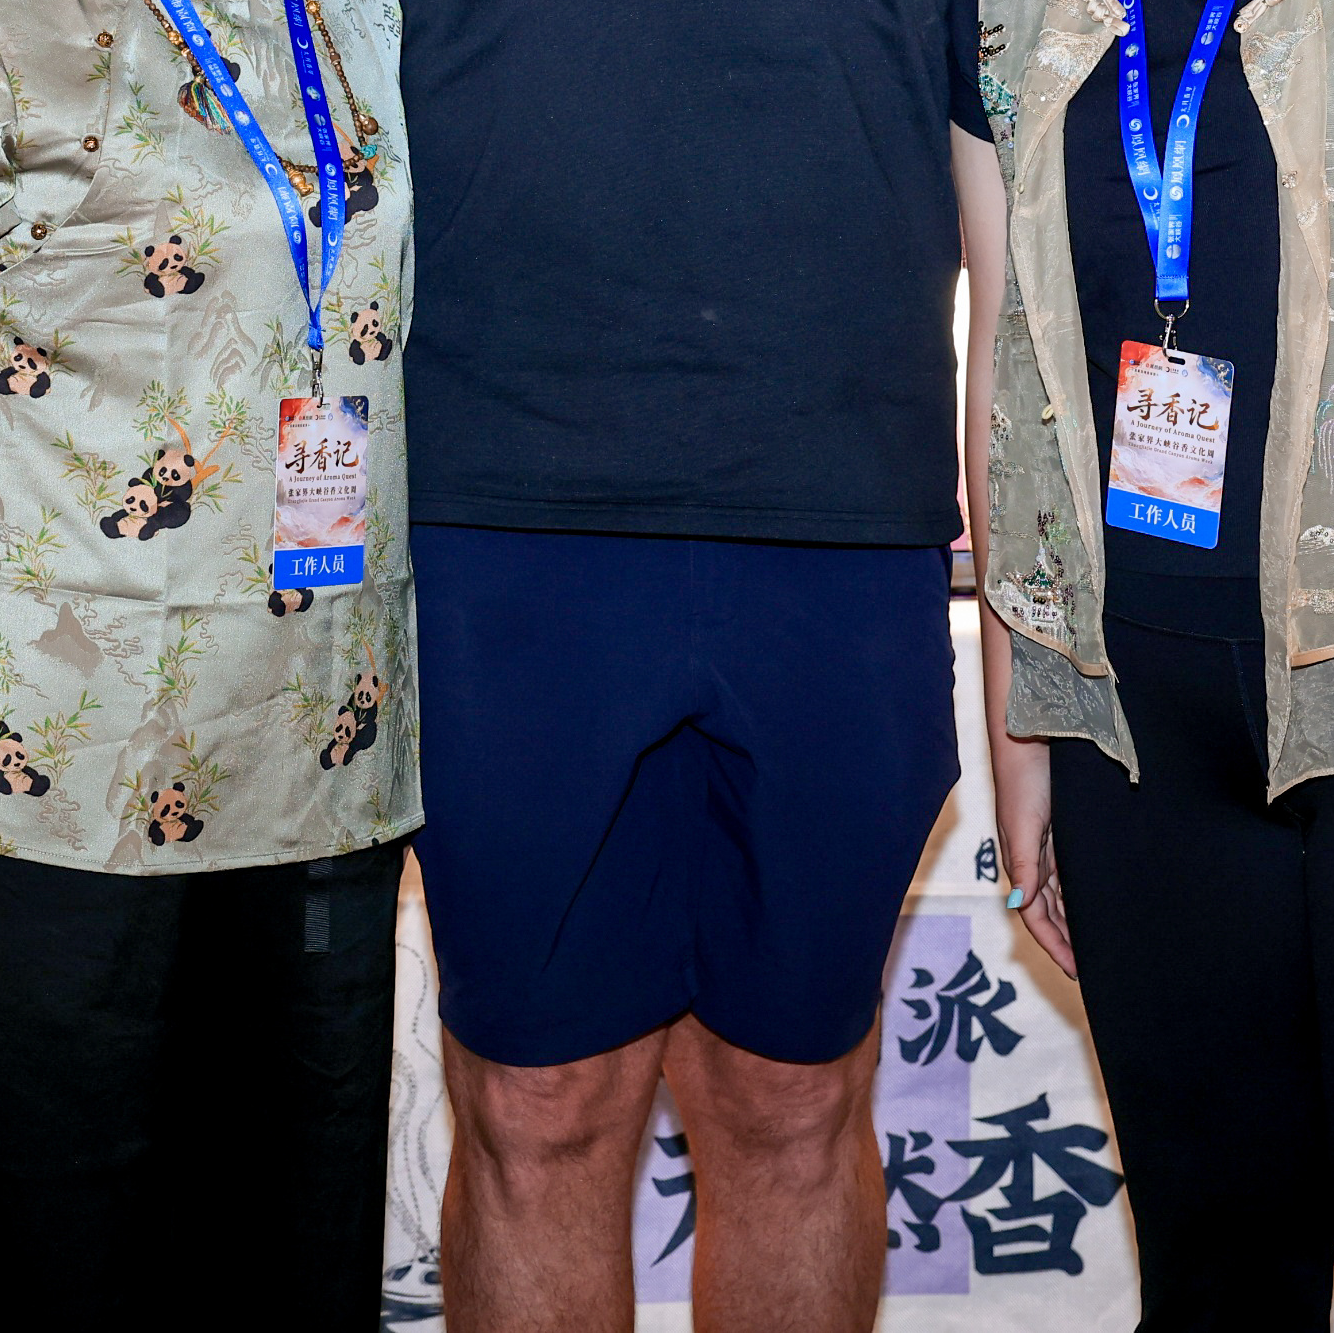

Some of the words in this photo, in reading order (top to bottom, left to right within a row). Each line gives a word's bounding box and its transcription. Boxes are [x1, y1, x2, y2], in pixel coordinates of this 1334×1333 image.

[1126, 387, 1220, 431] 寻香记
[1136, 420, 1163, 433] Journey
[1173, 429, 1195, 439] Aroma
[1196, 433, 1215, 444] Quest
[284, 437, 360, 474] 寻香记
[294, 475, 315, 483] Journey
[1128, 501, 1196, 534] 工作人员
[289, 553, 345, 577] 工作人员
